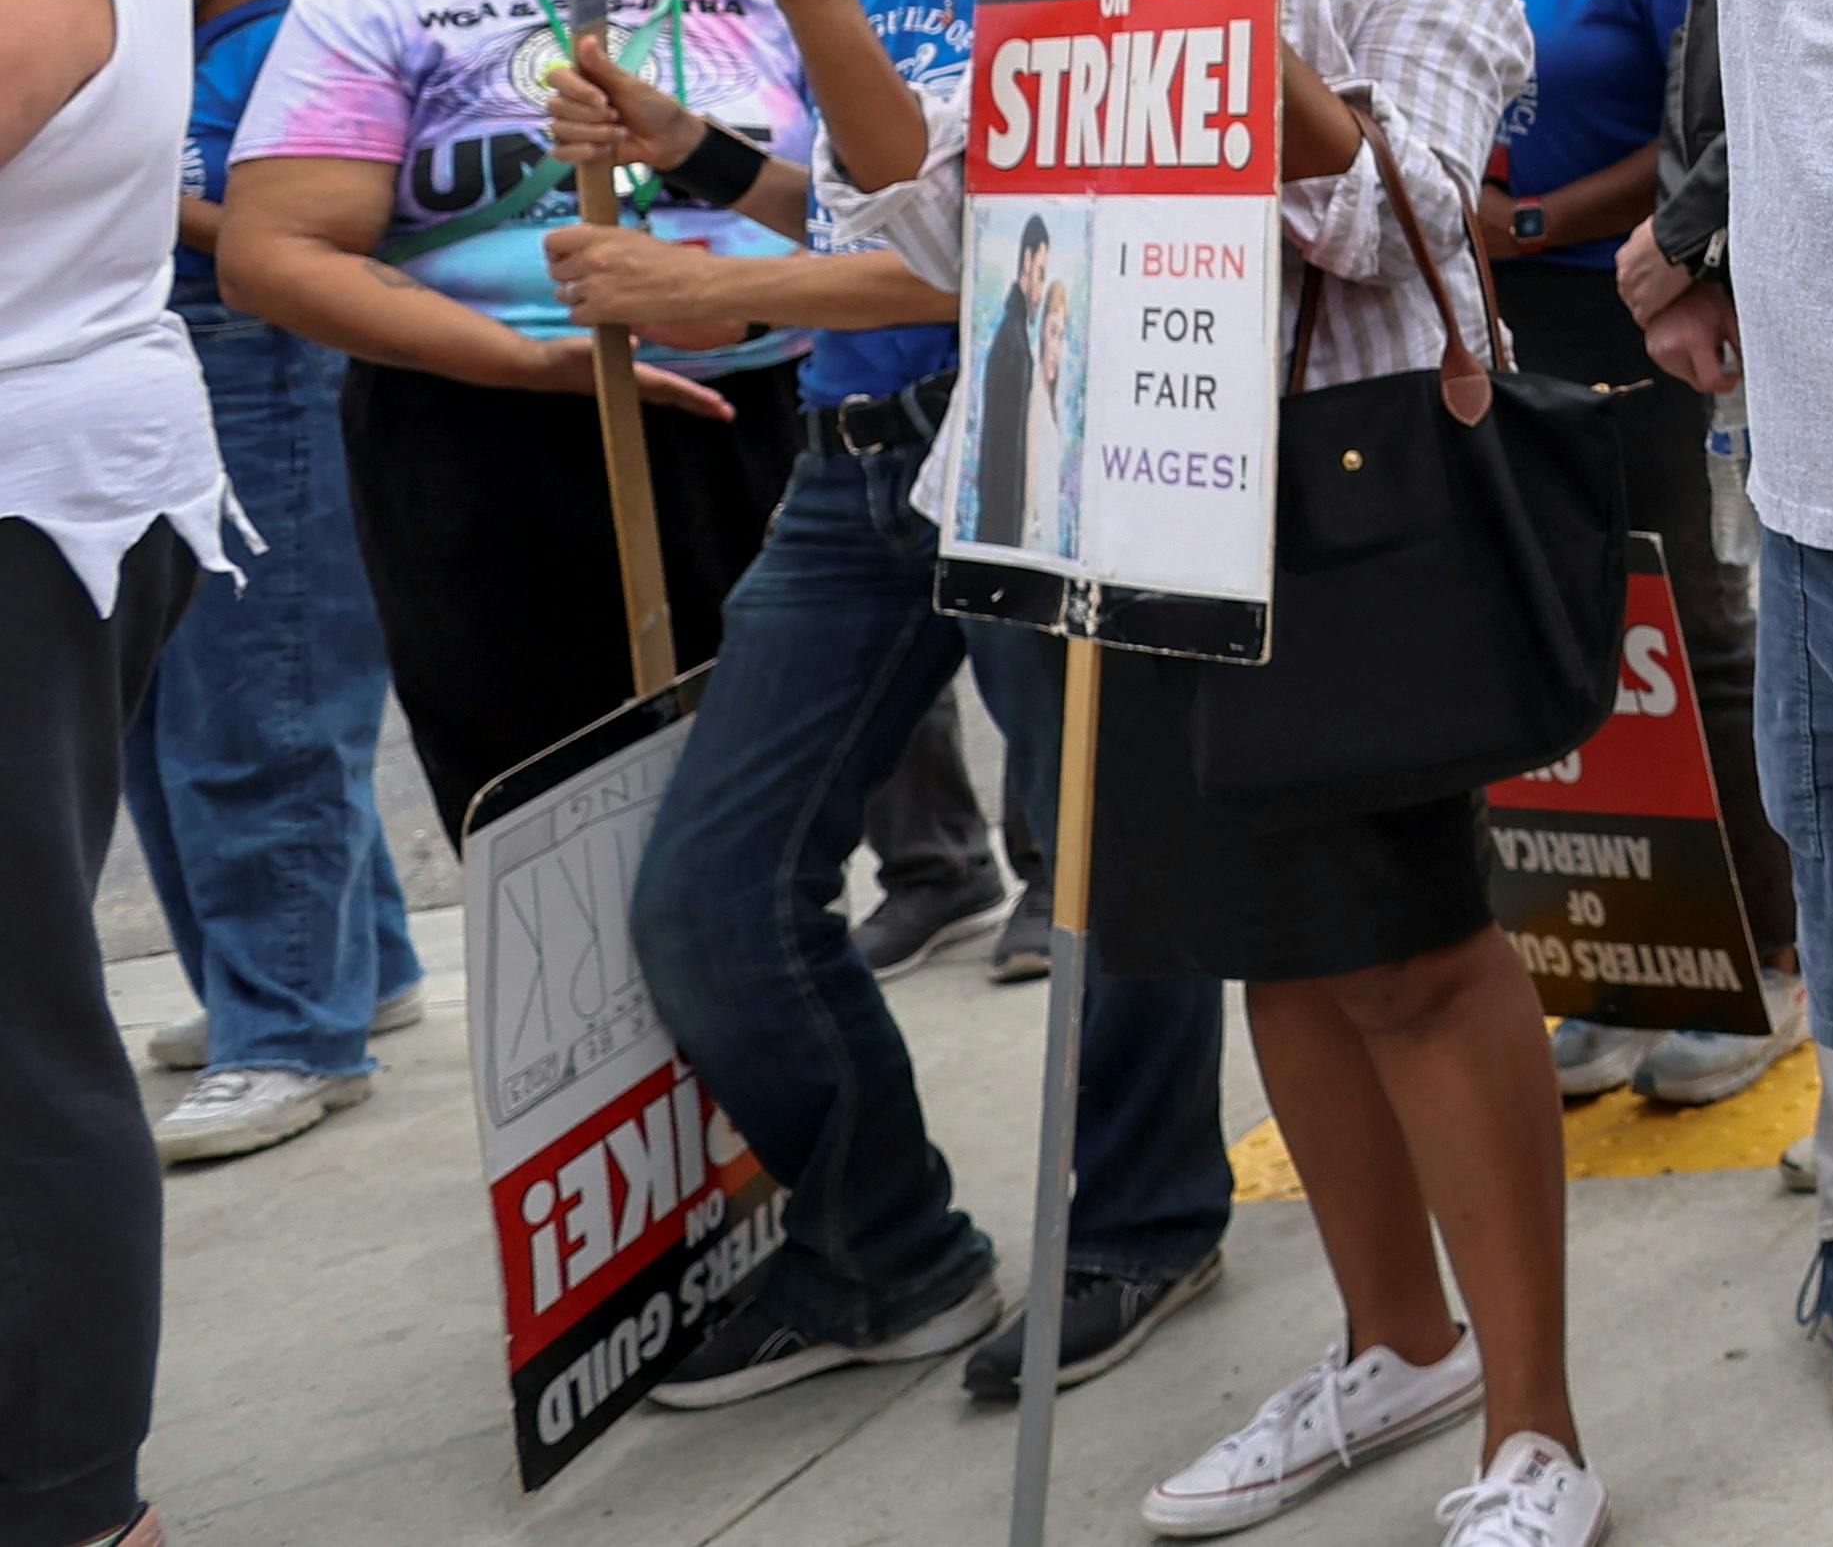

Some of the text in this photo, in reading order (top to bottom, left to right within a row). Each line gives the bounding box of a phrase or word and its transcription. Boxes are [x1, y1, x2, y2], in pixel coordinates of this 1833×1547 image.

[418, 2, 495, 29] WGA
[986, 19, 1253, 171] STRIKE!
[1119, 242, 1245, 280] I BURN
[1141, 307, 1215, 344] FOR
[1134, 372, 1217, 411] FAIR
[1101, 443, 1247, 492] WAGES!
[1491, 826, 1653, 880] AMERICA
[1567, 888, 1605, 928] OF
[1569, 938, 1743, 992] WRITERS
[684, 1186, 726, 1249] ON
[537, 1287, 675, 1447] GUILD
